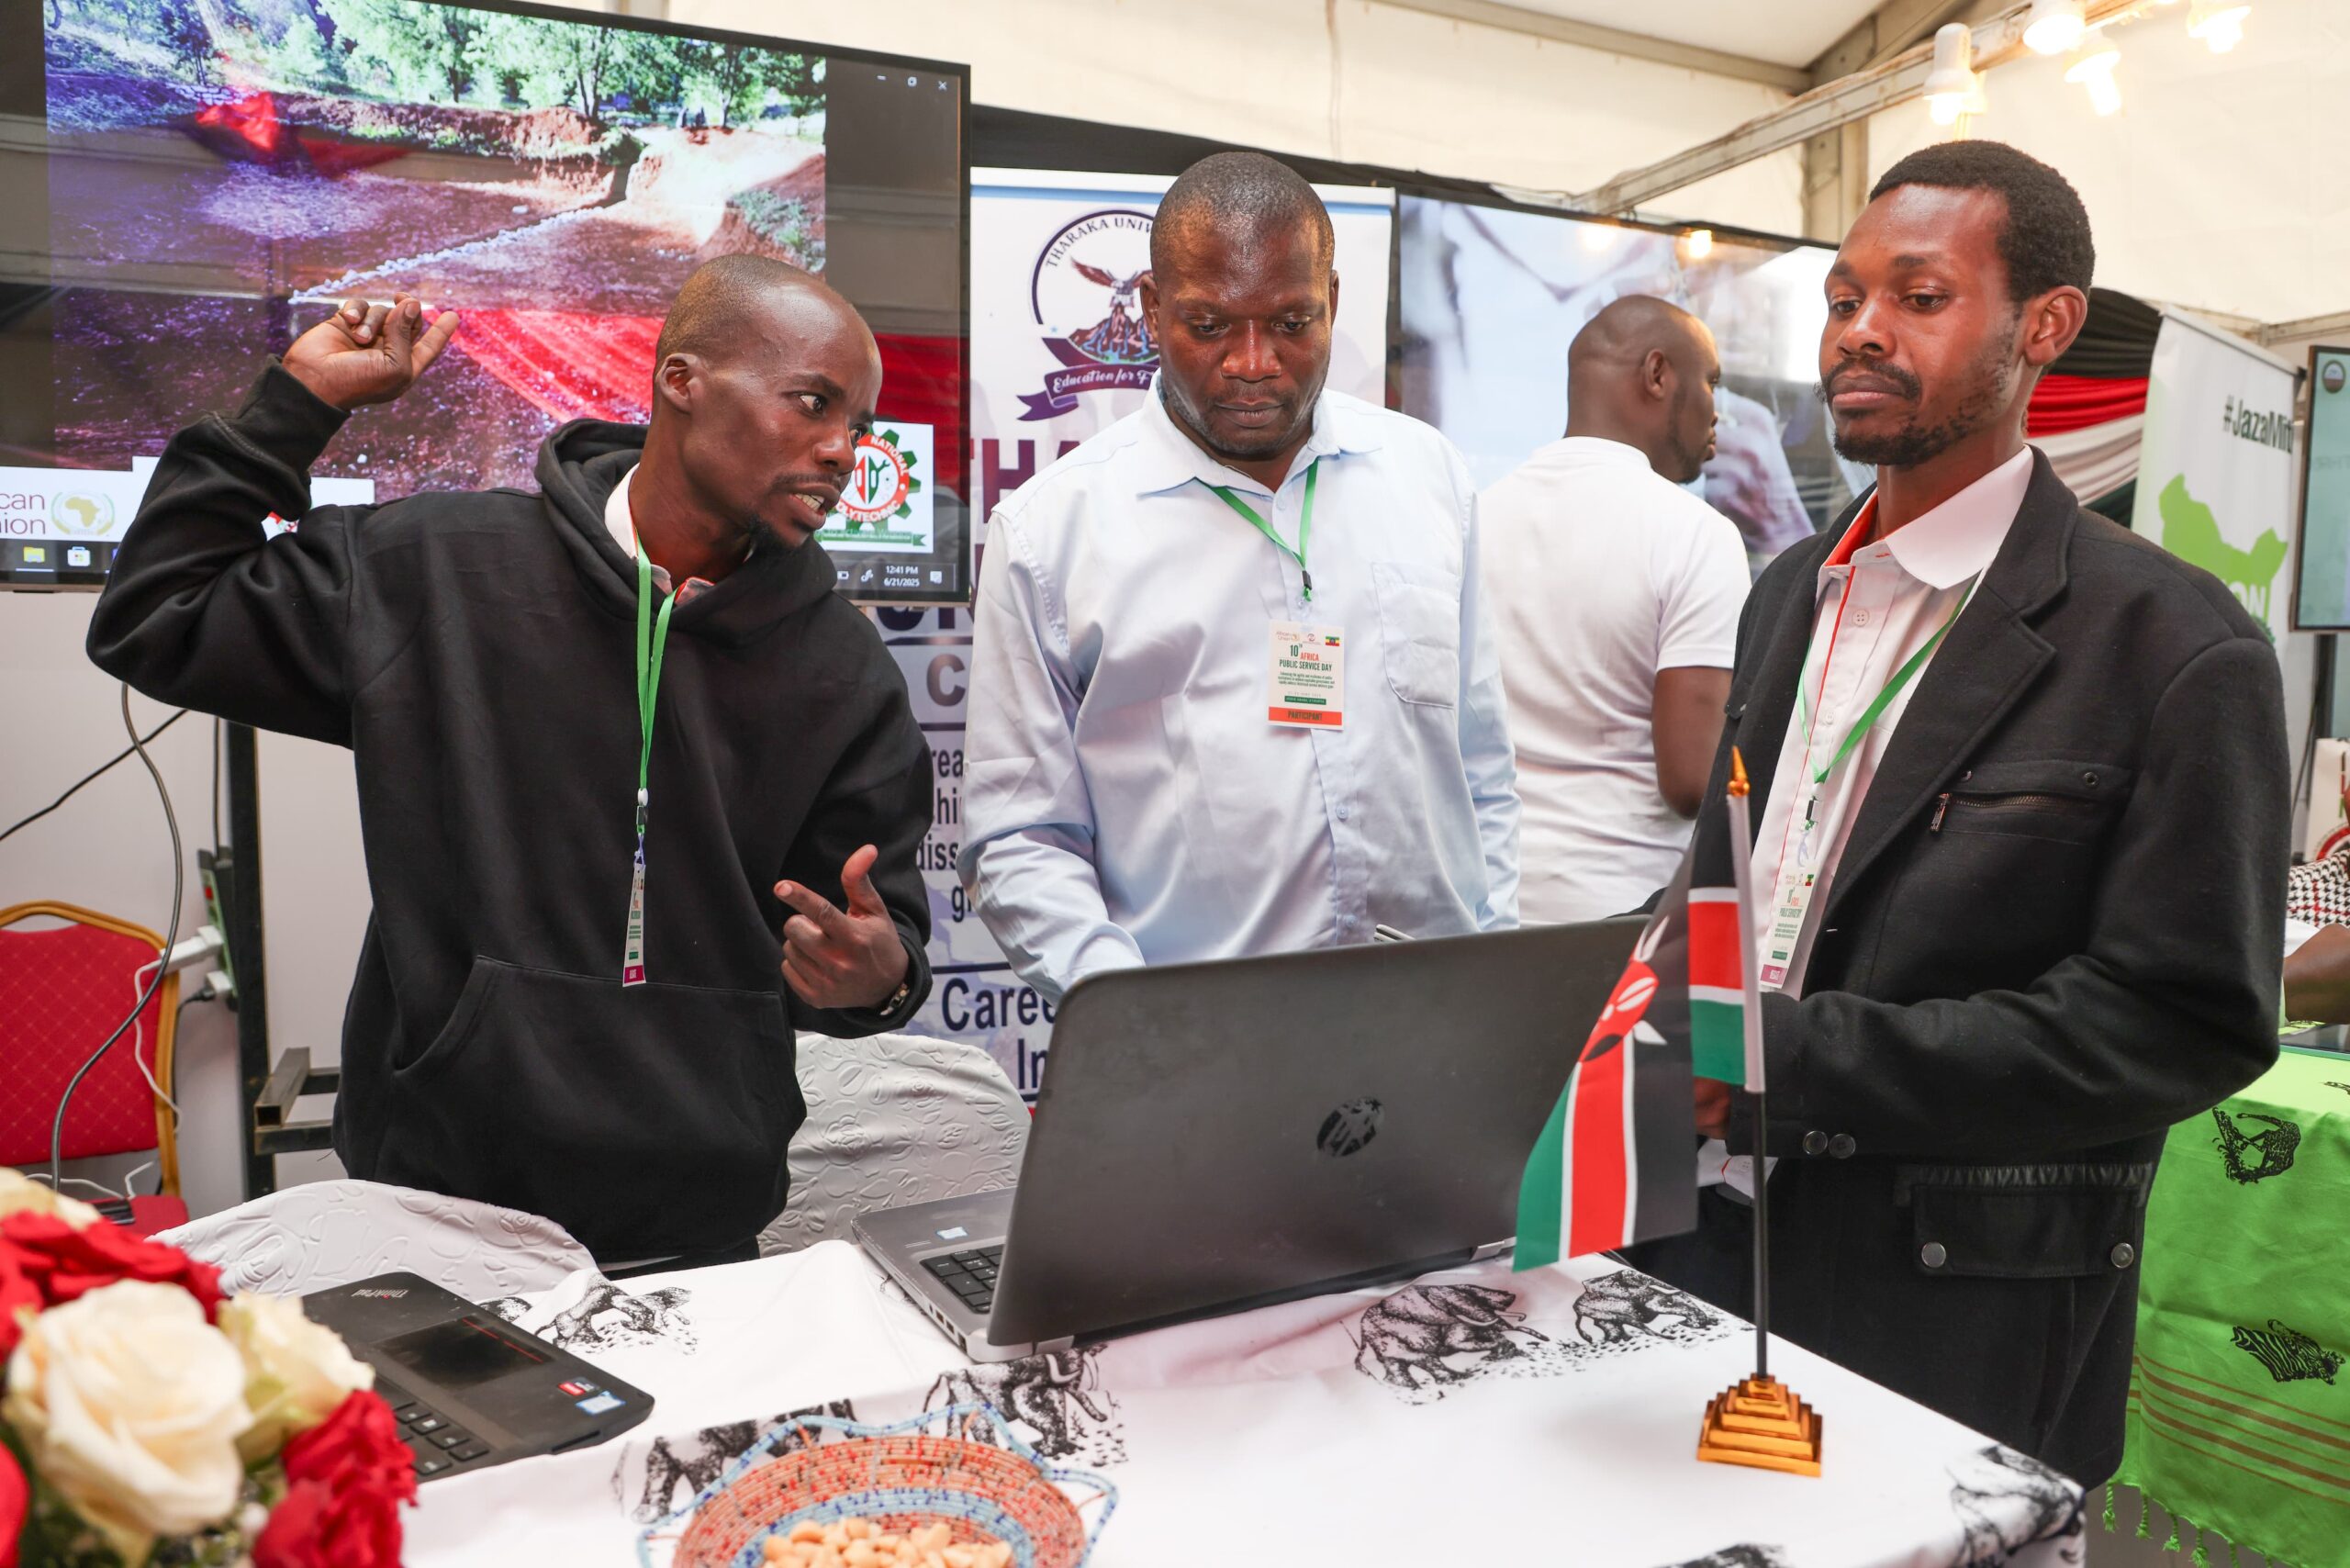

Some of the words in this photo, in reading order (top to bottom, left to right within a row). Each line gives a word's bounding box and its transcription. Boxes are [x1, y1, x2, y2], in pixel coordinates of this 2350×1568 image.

[1045, 218, 1109, 268] THARAKA
[1052, 369, 1113, 394] Education
[1113, 367, 1134, 385] for
[870, 435, 909, 476] NATIONAL
[0, 511, 46, 535] ion
[886, 565, 904, 575] 12:41
[905, 565, 919, 575] PM
[883, 577, 920, 588] 6/21/2025
[1300, 652, 1319, 662] AFRICA
[1279, 658, 1298, 669] PUBLIC
[1298, 660, 1320, 671] SERVICE
[1321, 662, 1333, 672] DAY
[1287, 711, 1323, 722] PARTICIPANT
